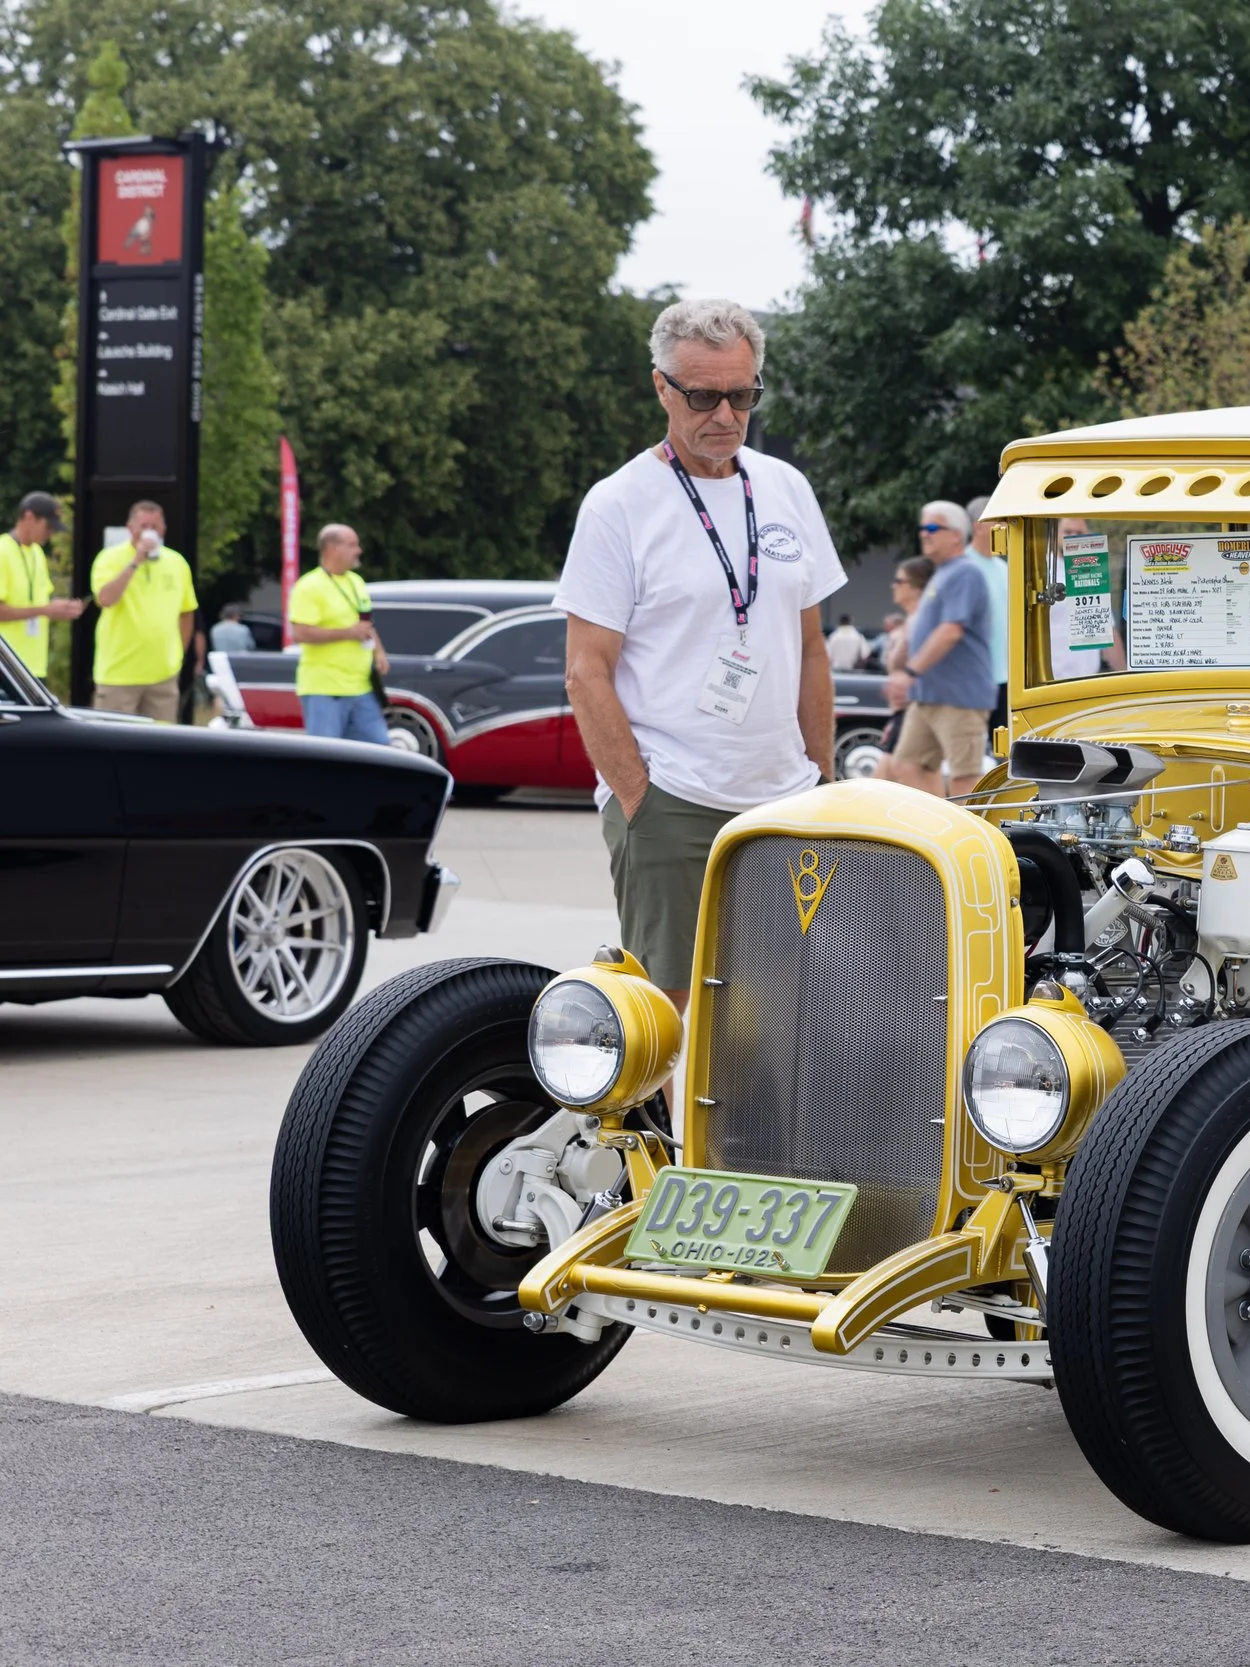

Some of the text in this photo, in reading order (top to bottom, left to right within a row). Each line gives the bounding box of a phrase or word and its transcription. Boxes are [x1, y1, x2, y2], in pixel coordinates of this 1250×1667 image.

[1140, 543, 1193, 560] GOODGUYS
[1075, 595, 1101, 607] 3071
[644, 1177, 844, 1250] D39-337
